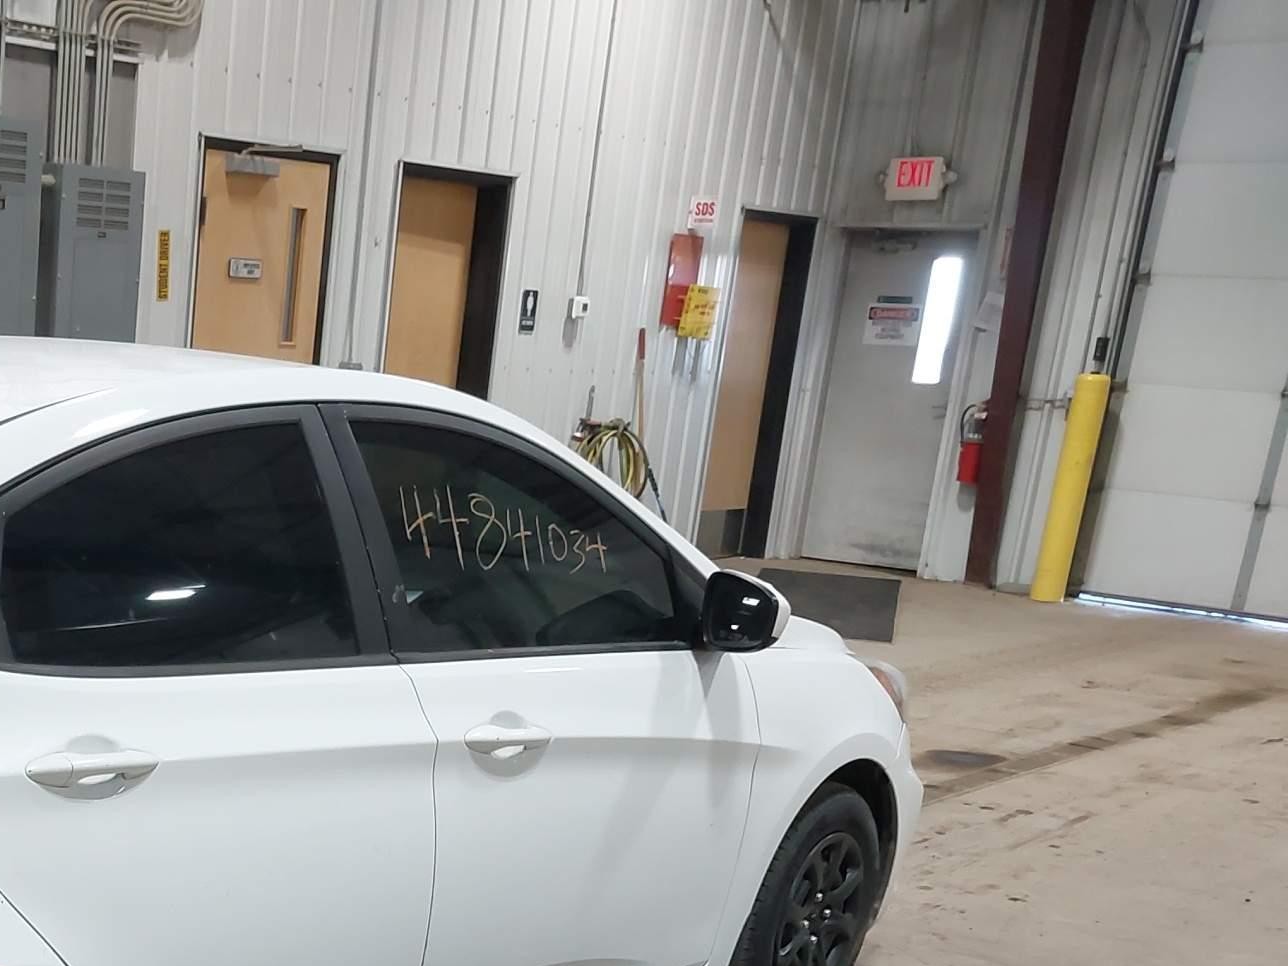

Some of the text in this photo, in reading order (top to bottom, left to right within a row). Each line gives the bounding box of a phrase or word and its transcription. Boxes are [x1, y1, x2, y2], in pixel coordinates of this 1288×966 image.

[897, 160, 935, 187] EXIT
[695, 202, 716, 216] SDS
[399, 484, 607, 574] 44841034
